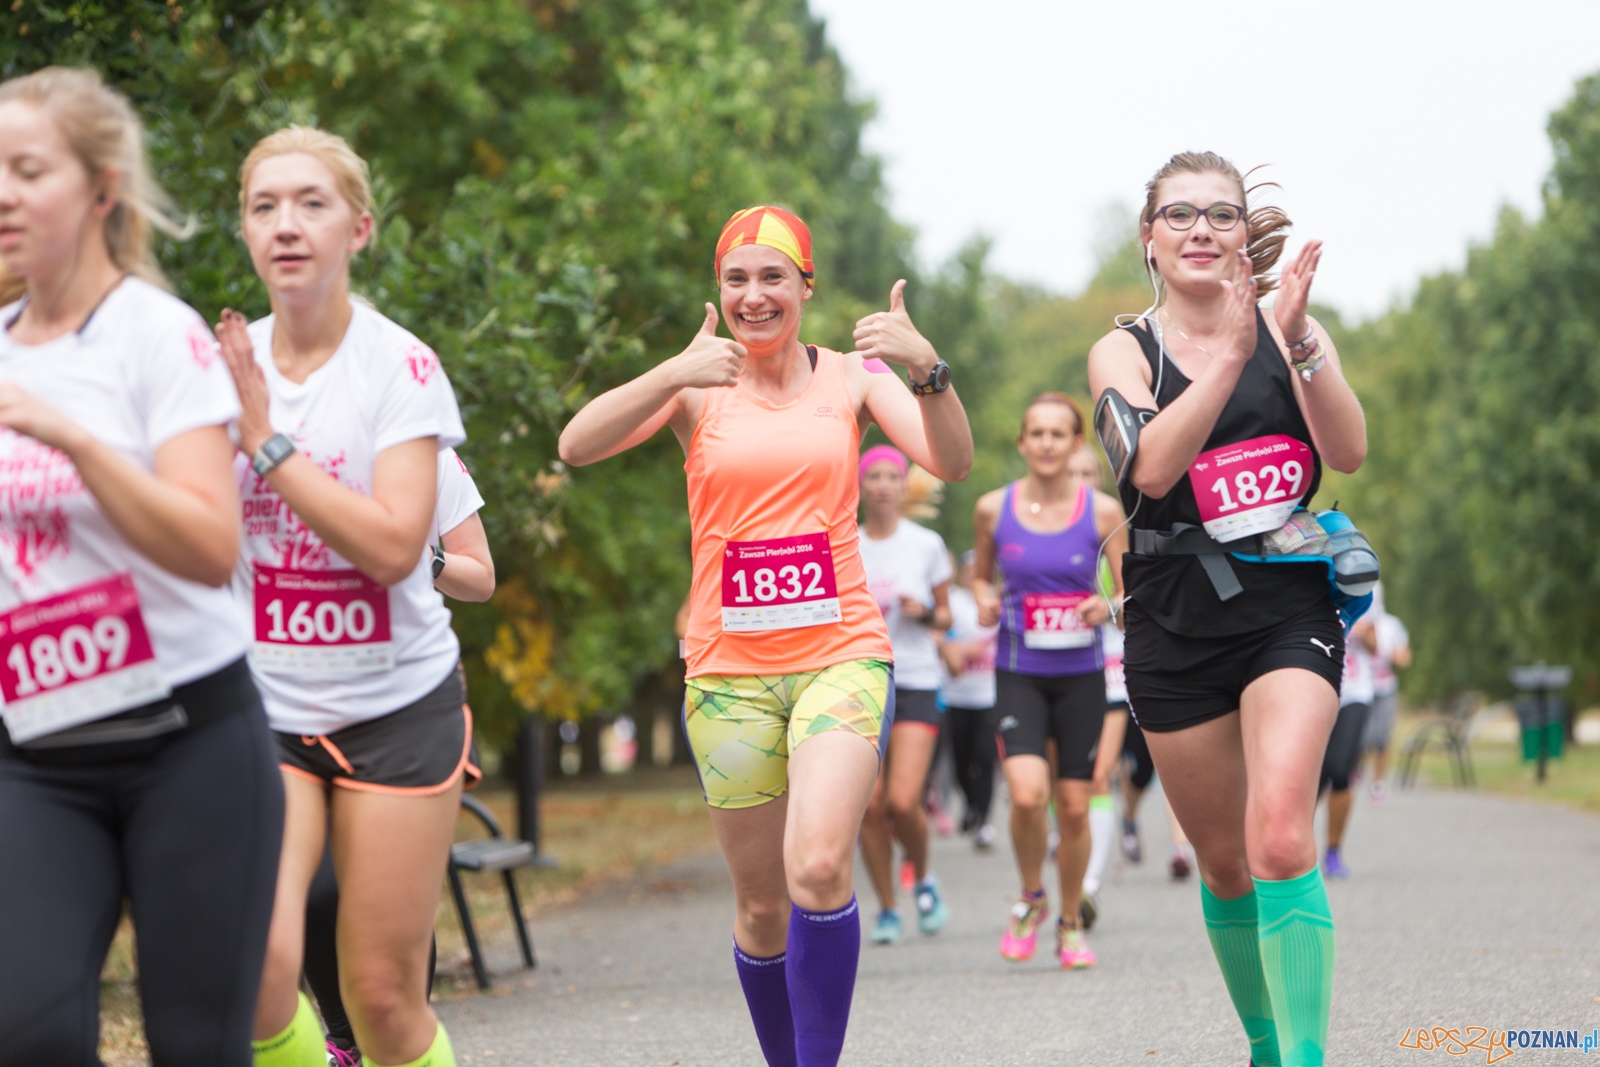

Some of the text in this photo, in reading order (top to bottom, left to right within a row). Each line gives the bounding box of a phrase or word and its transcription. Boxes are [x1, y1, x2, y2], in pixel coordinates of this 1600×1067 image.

[1216, 454, 1243, 467] Zawsze
[1273, 442, 1290, 452] 2016
[1211, 460, 1303, 513] 1829
[739, 550, 765, 559] Zawsze
[796, 544, 813, 553] 2016
[731, 562, 826, 603] 1832
[265, 598, 376, 643] 1600
[6, 614, 131, 698] 1809
[738, 953, 787, 966] ZEROPOI
